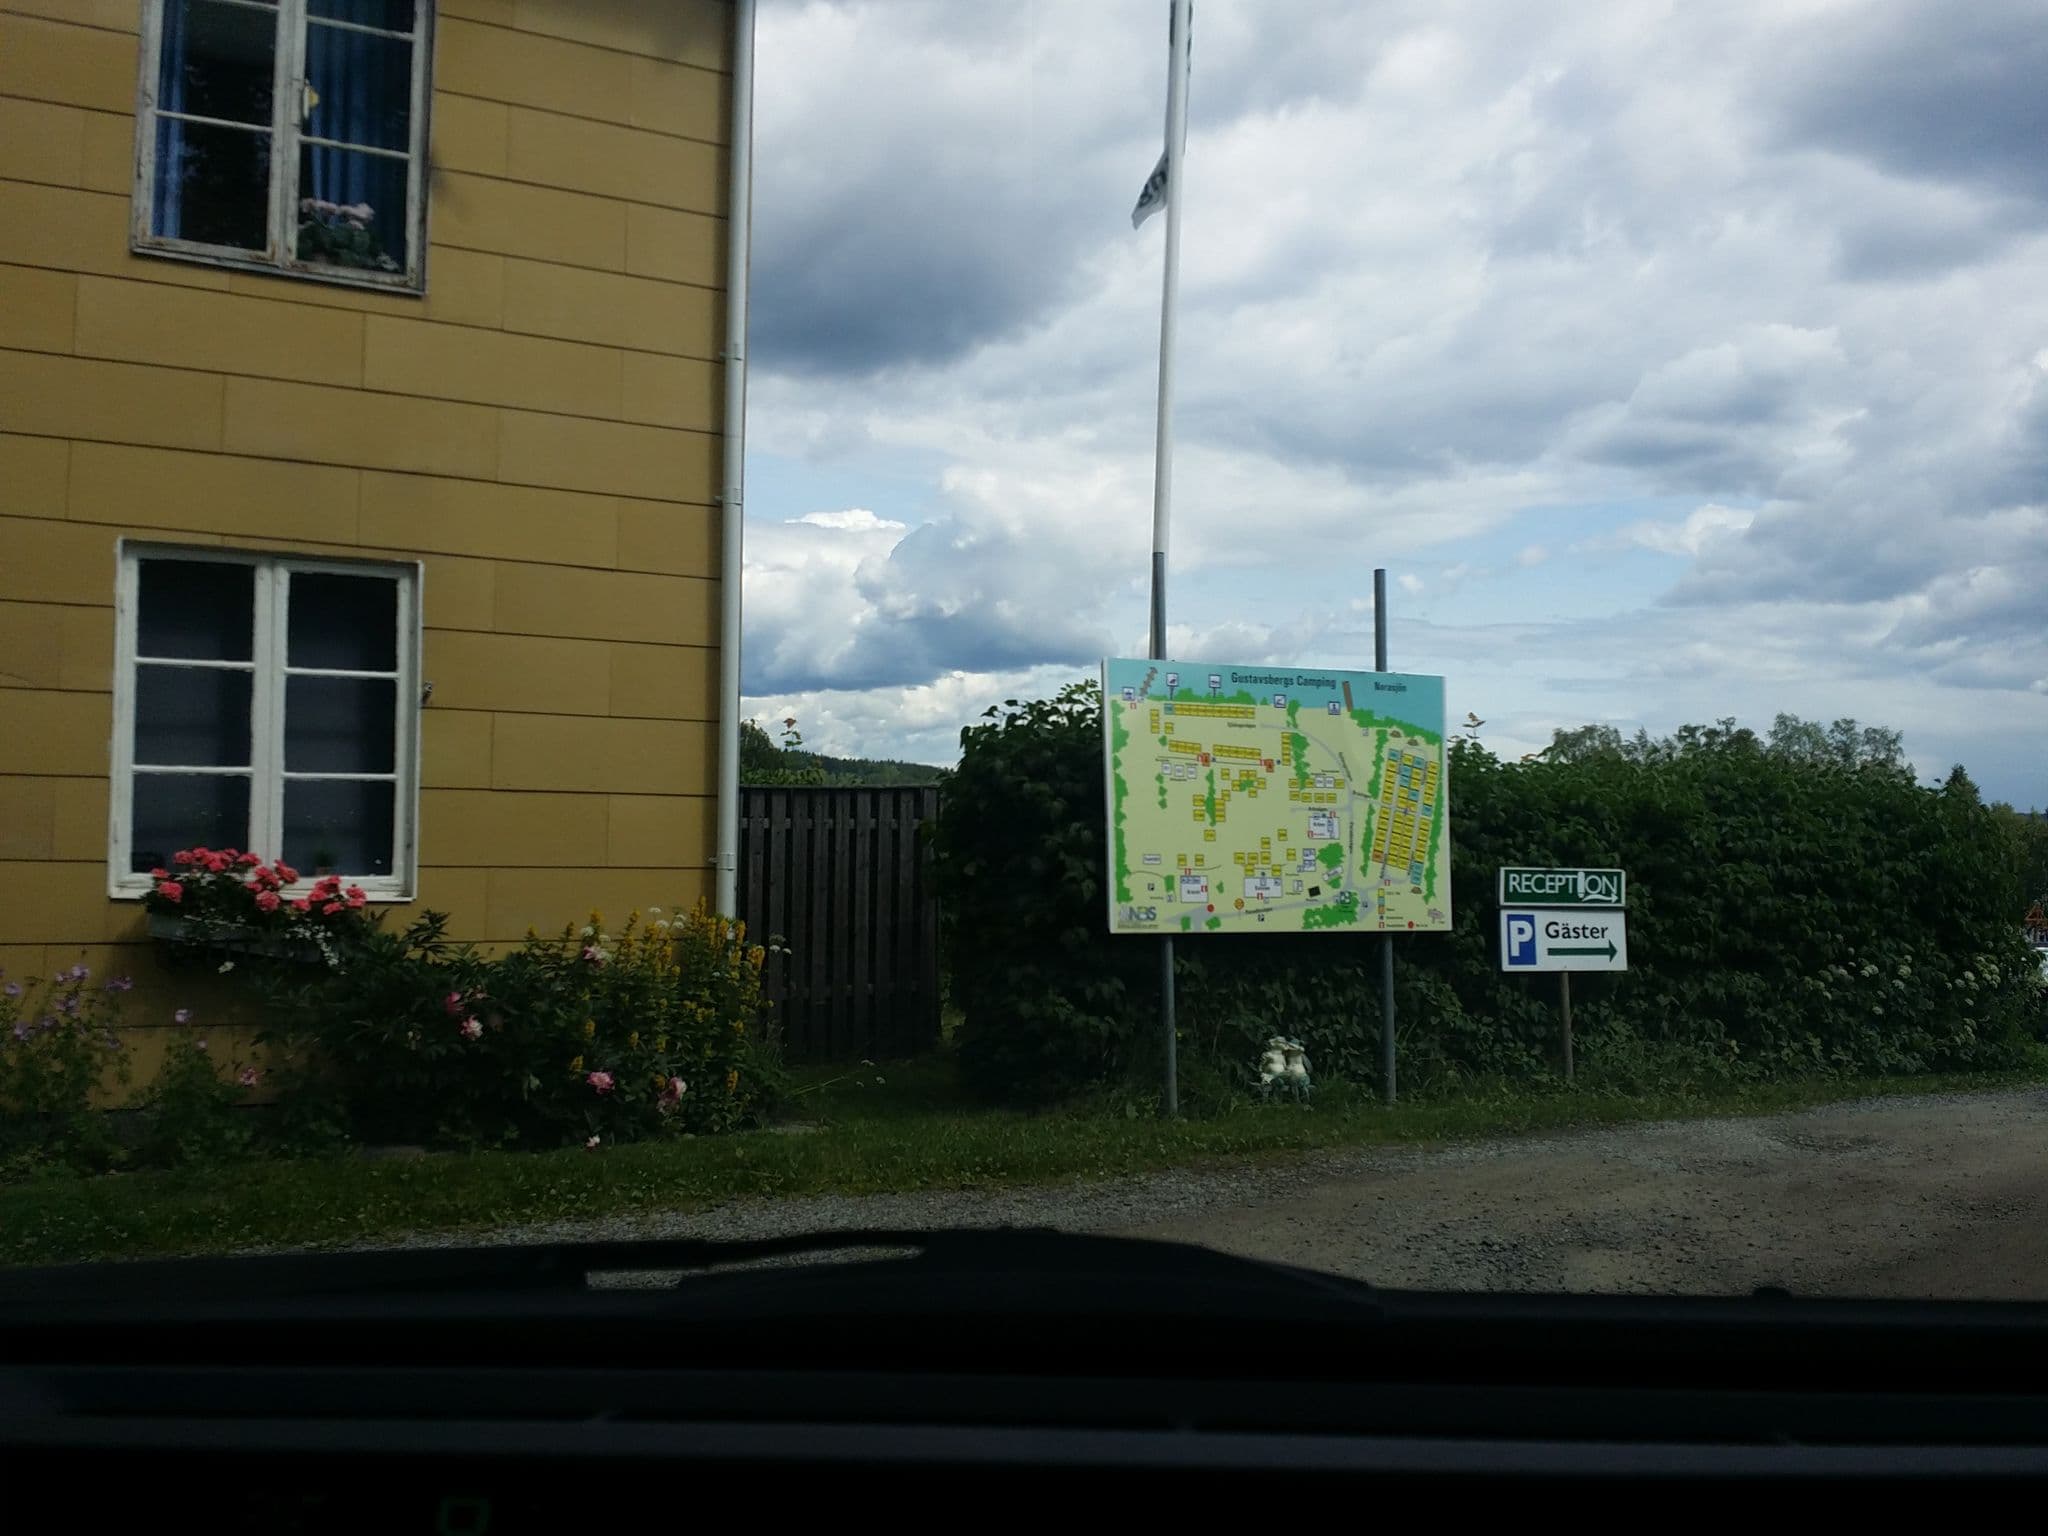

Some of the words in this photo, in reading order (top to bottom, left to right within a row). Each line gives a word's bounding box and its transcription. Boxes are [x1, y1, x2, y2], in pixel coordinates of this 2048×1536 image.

[1231, 672, 1294, 688] Gustavsbergs
[1297, 675, 1336, 690] Camping
[1508, 871, 1618, 896] RECEPTION
[1508, 920, 1534, 957] P
[1545, 921, 1609, 940] Gäster
